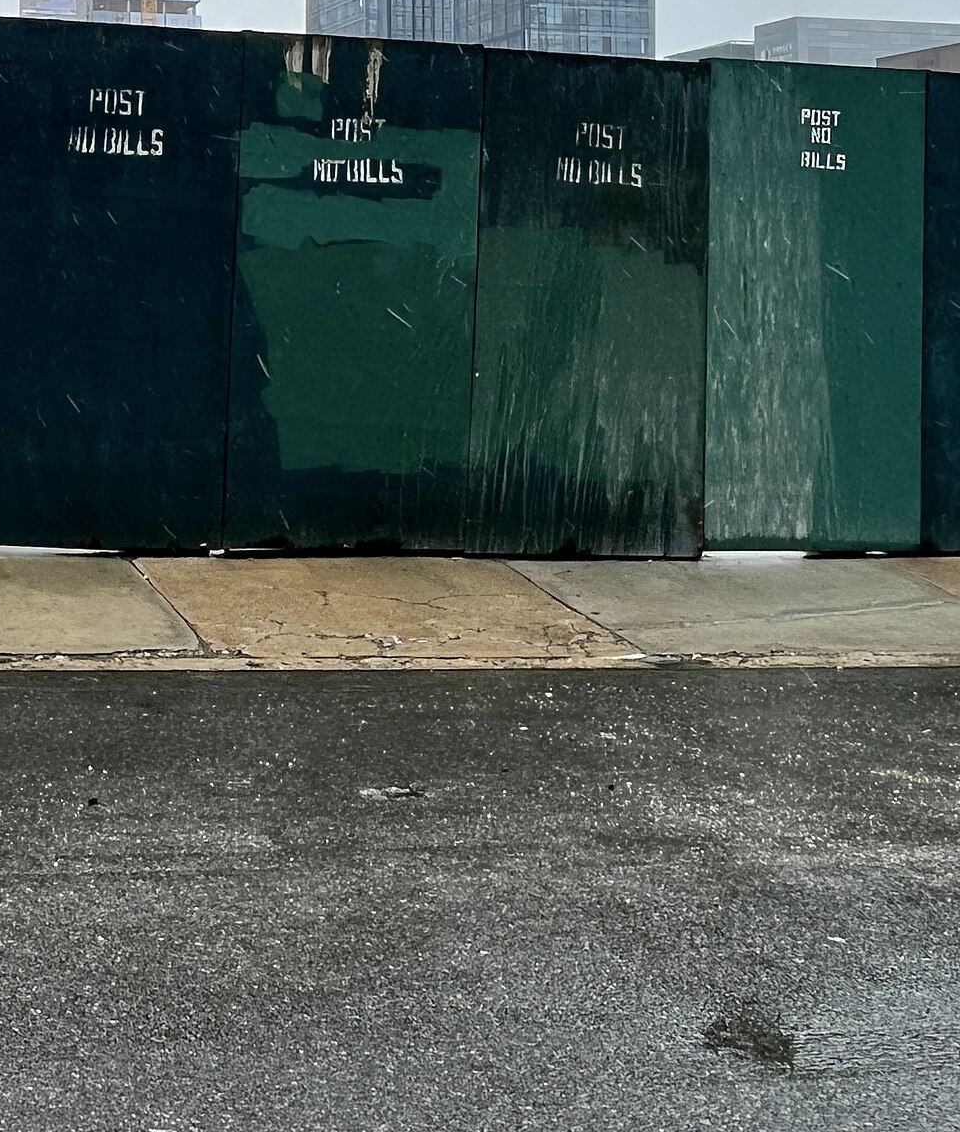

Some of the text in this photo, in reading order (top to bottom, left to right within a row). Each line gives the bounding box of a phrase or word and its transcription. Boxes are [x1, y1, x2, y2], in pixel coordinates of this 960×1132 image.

[89, 88, 146, 117] POST
[331, 118, 386, 143] POST
[801, 108, 842, 127] POST
[103, 127, 164, 156] BILLS
[575, 122, 625, 150] POST
[811, 127, 831, 144] NO
[346, 158, 403, 184] BILLS
[556, 156, 642, 188] NO BILLS
[800, 151, 846, 171] BILLS
